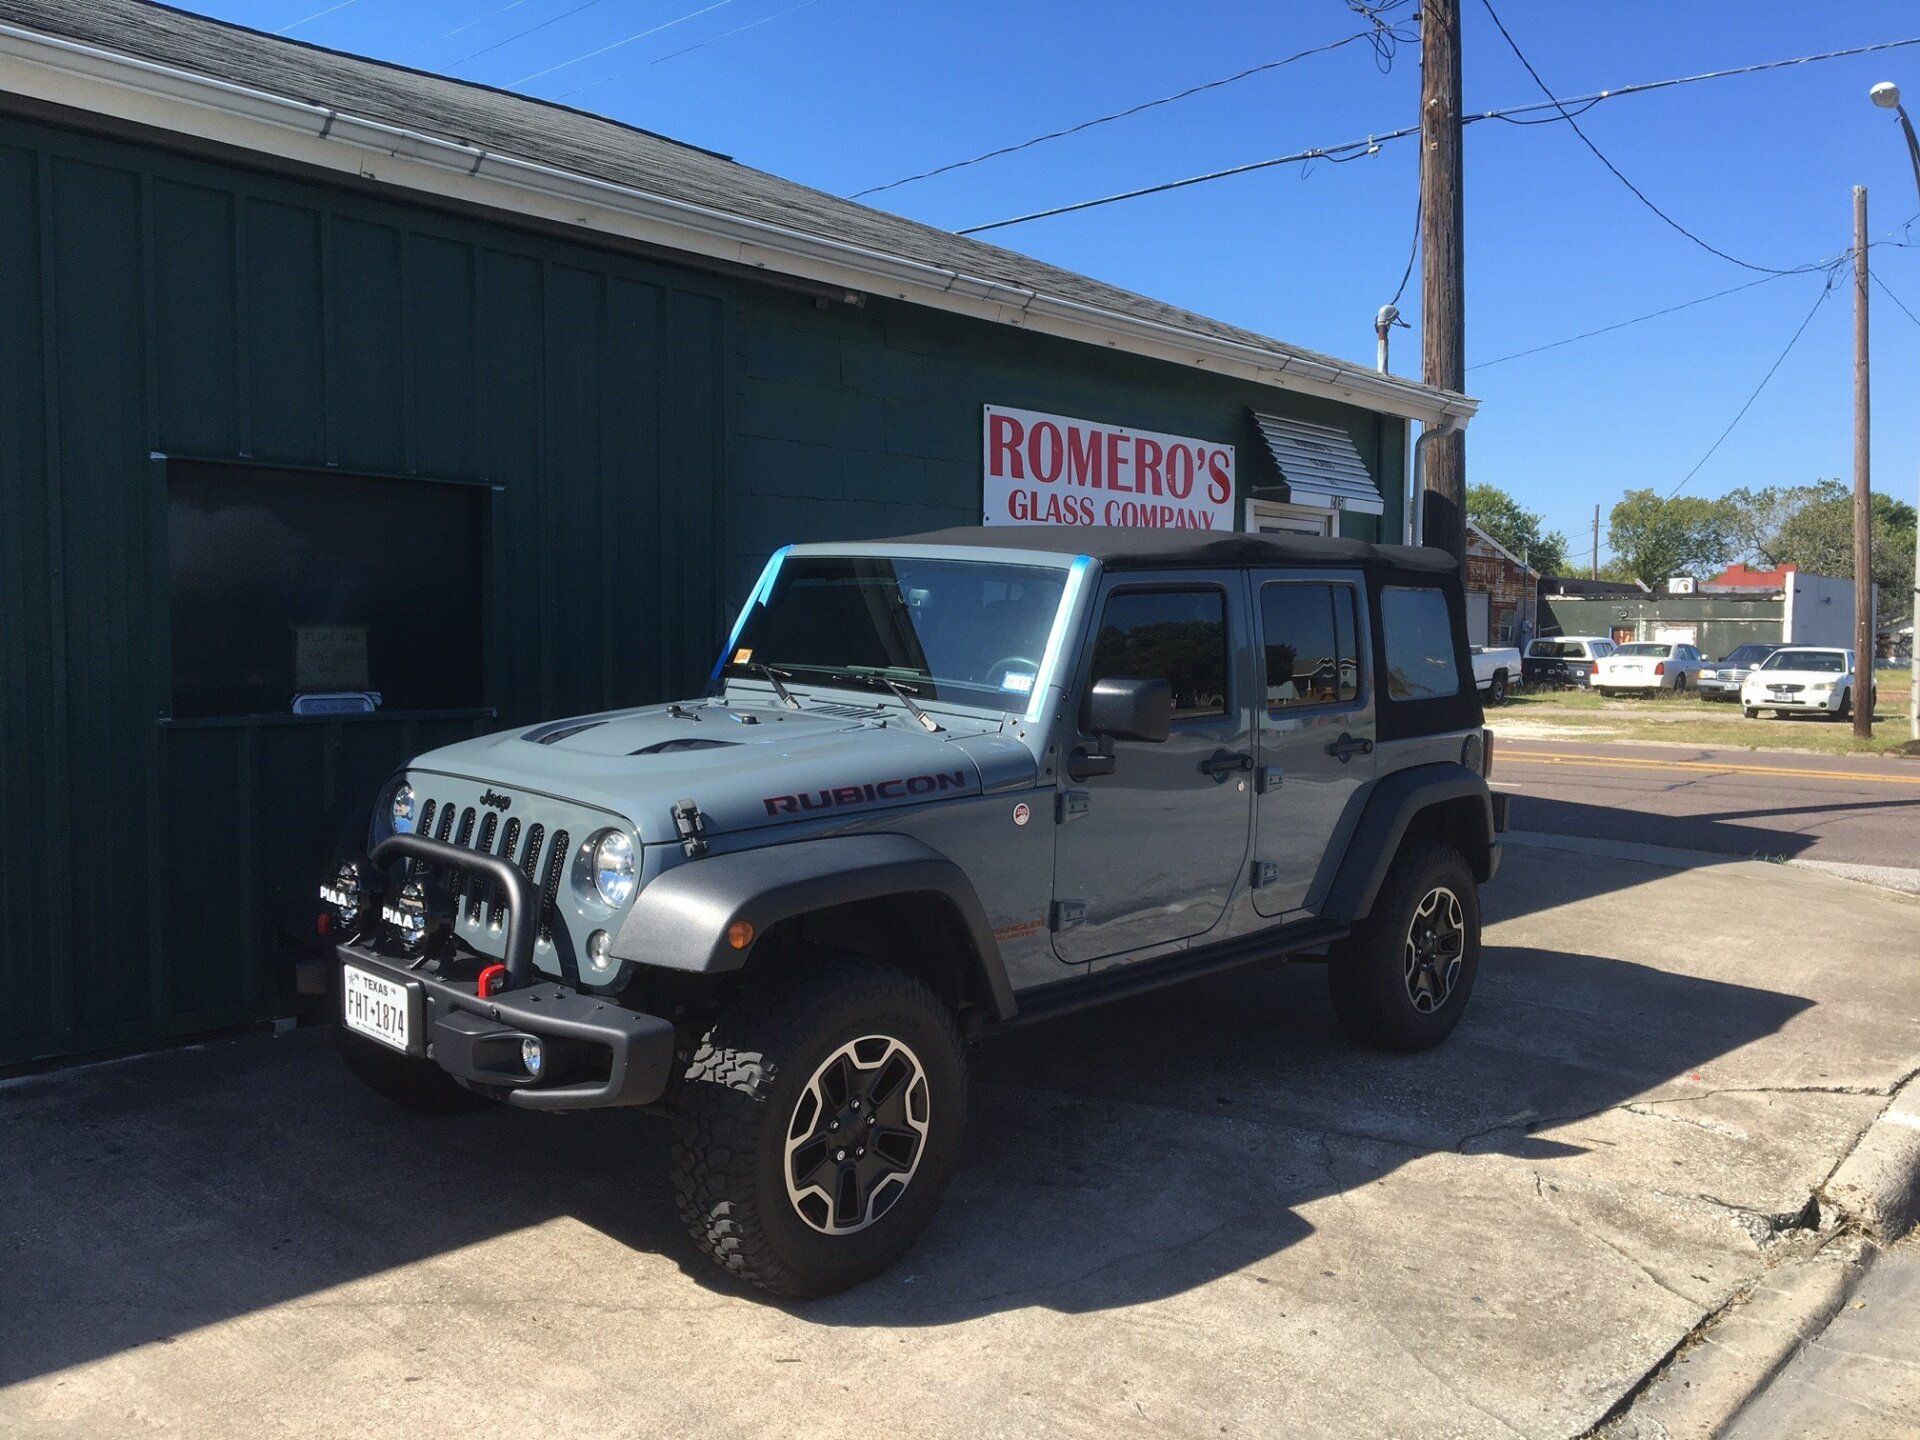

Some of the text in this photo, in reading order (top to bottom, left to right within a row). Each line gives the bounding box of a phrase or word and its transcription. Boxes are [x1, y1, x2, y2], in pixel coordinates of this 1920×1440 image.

[989, 413, 1231, 505] ROMERO'S
[1008, 489, 1215, 530] GLASS COMPANY
[479, 788, 512, 813] Jeep
[763, 770, 967, 817] RUBICON
[320, 885, 348, 907] PIAA
[382, 906, 414, 930] PIAA
[363, 976, 389, 997] TEXAS
